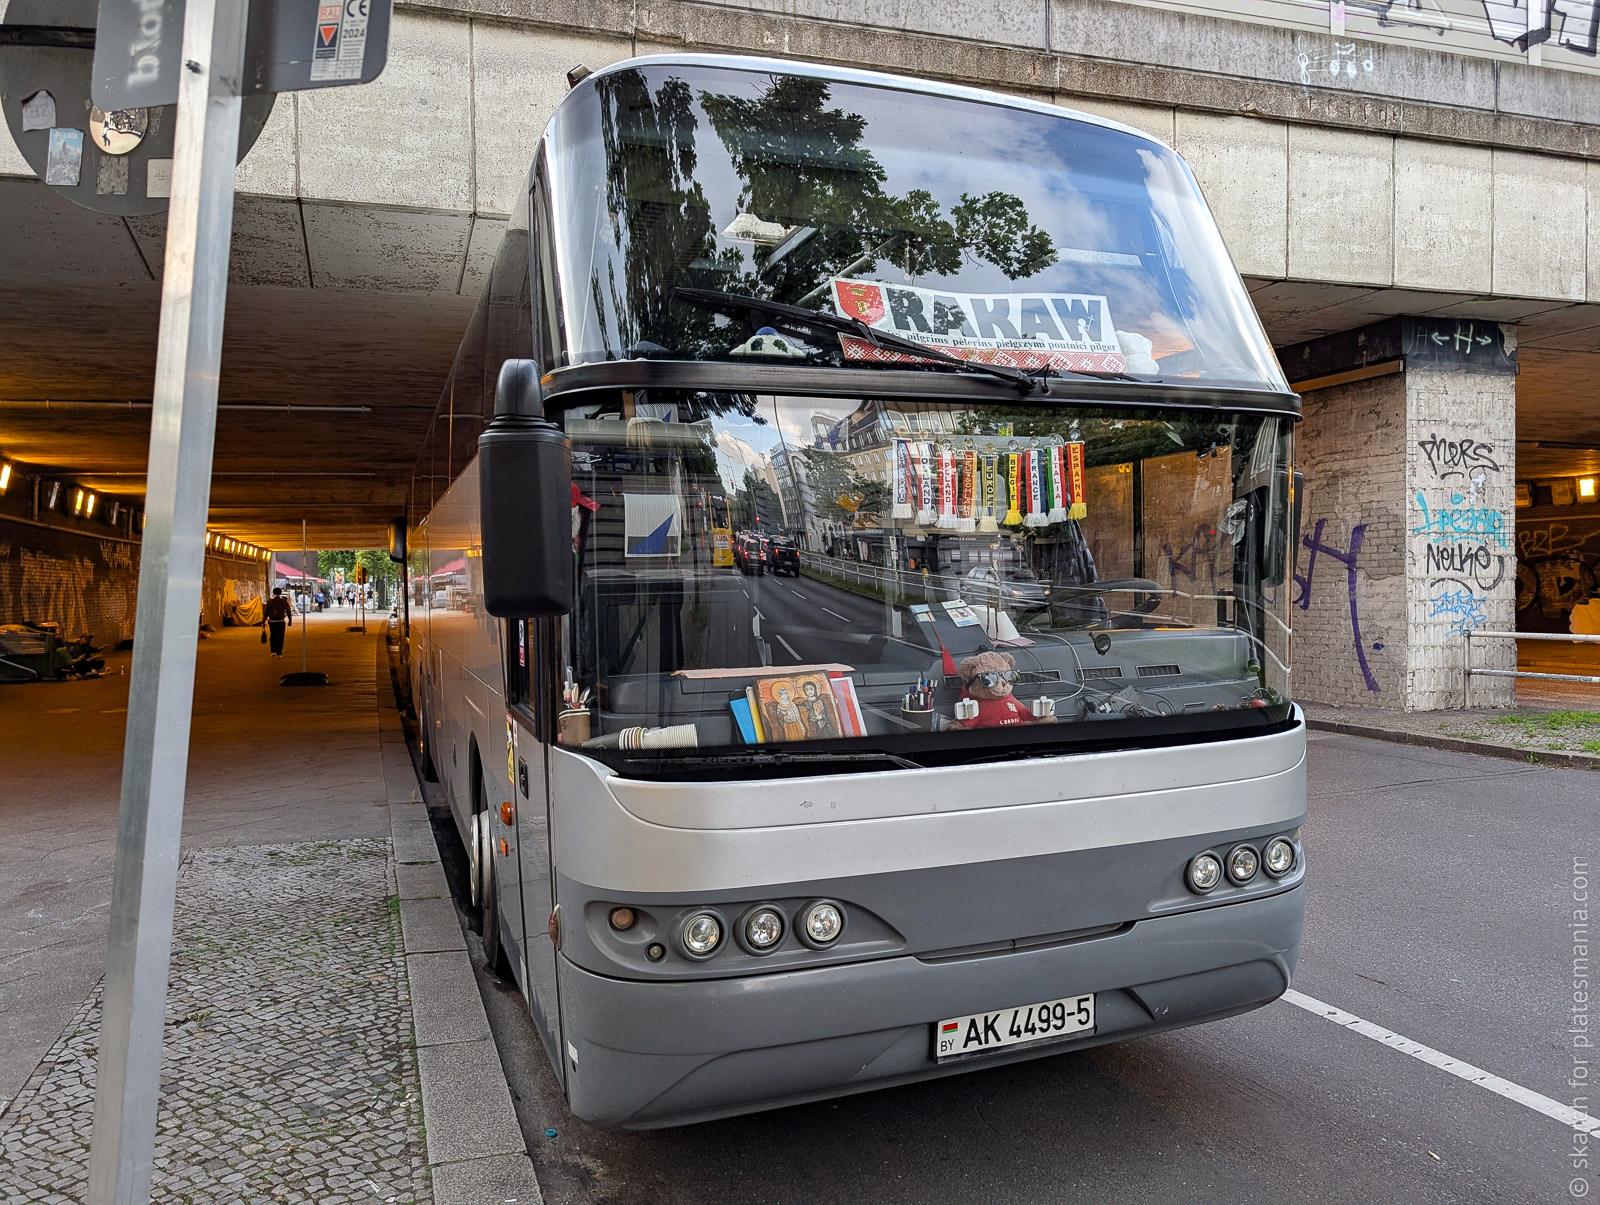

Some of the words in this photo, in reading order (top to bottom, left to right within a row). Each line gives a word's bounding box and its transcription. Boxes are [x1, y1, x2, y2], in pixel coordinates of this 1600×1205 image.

[320, 7, 341, 18] RAL
[342, 28, 366, 39] 2024
[885, 286, 1103, 342] RAKAW
[906, 332, 949, 345] pilgrims
[995, 340, 1046, 350] pielgrzymi
[1089, 342, 1116, 352] pilger
[943, 462, 952, 503] POLAND
[1031, 458, 1040, 501] FRANCE
[1053, 455, 1062, 499] ITALIA
[962, 1013, 1002, 1048] AK
[1008, 997, 1091, 1038] 4499-5
[940, 1039, 954, 1052] BY
